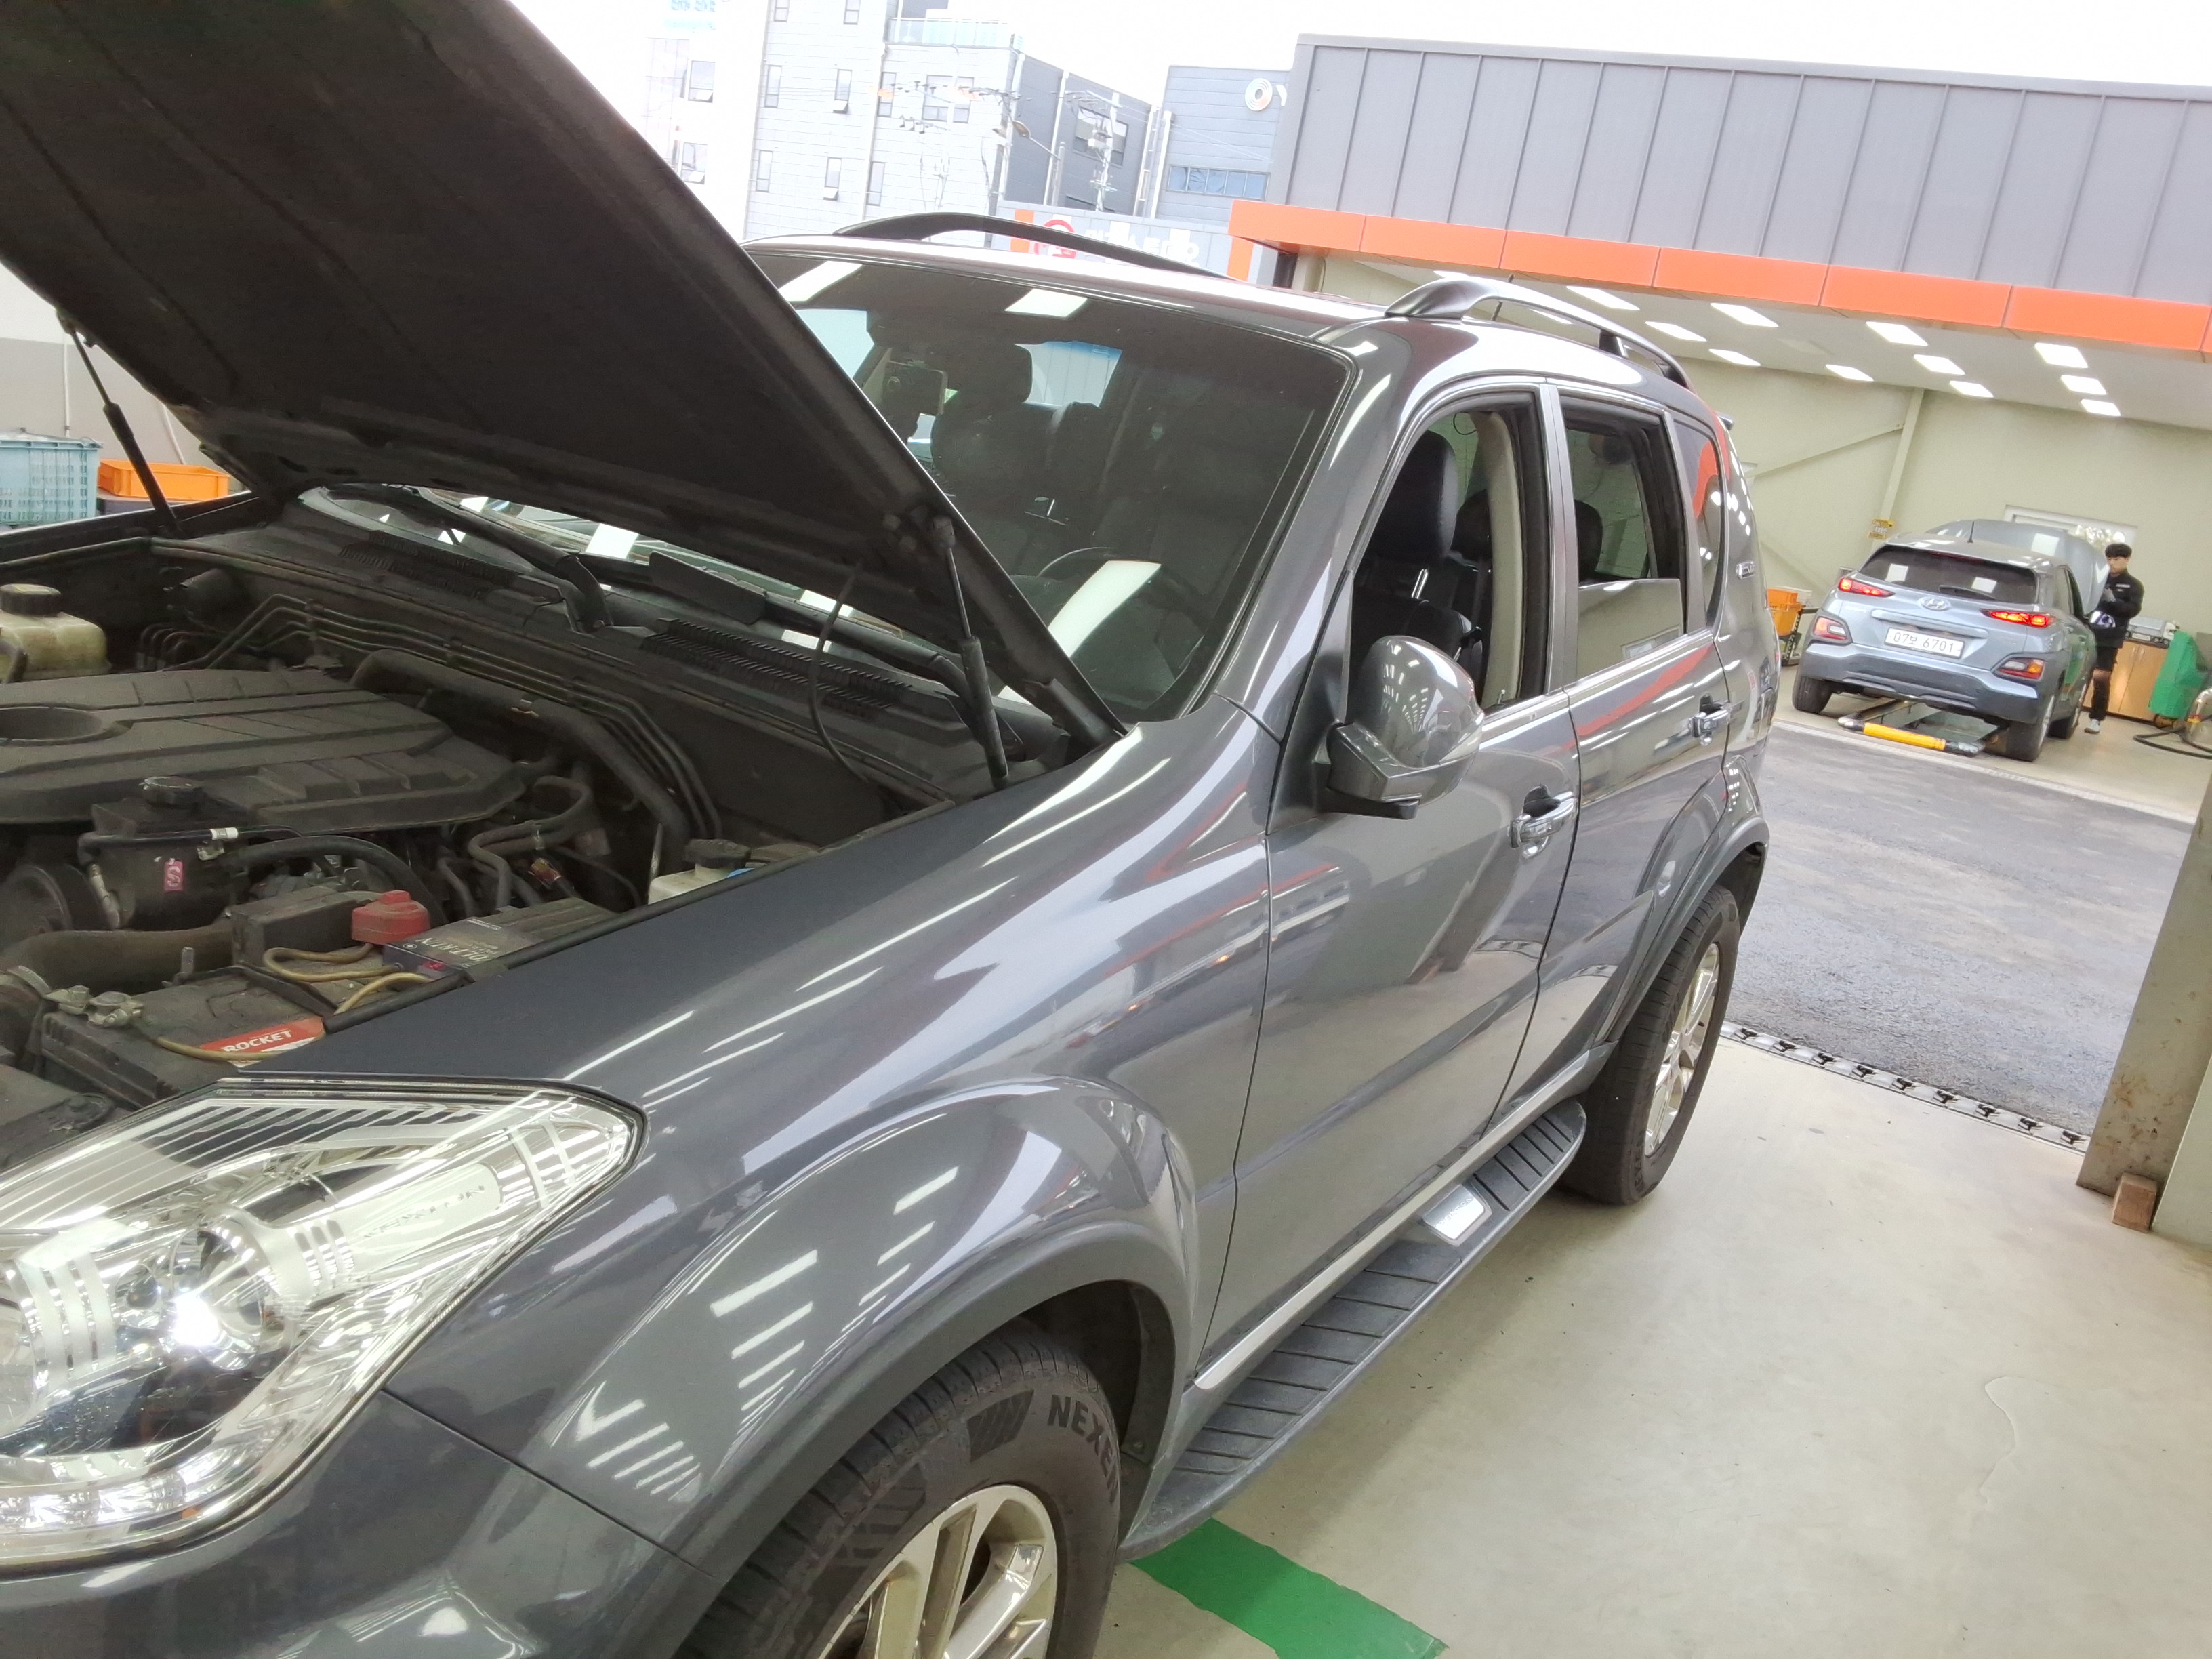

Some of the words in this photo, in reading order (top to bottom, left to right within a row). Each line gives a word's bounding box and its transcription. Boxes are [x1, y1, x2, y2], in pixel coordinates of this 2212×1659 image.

[1893, 632, 1918, 645] 07보
[1923, 638, 1954, 653] 6701
[220, 1029, 293, 1052] ROCKET
[1048, 1394, 1119, 1505] NEXEN
